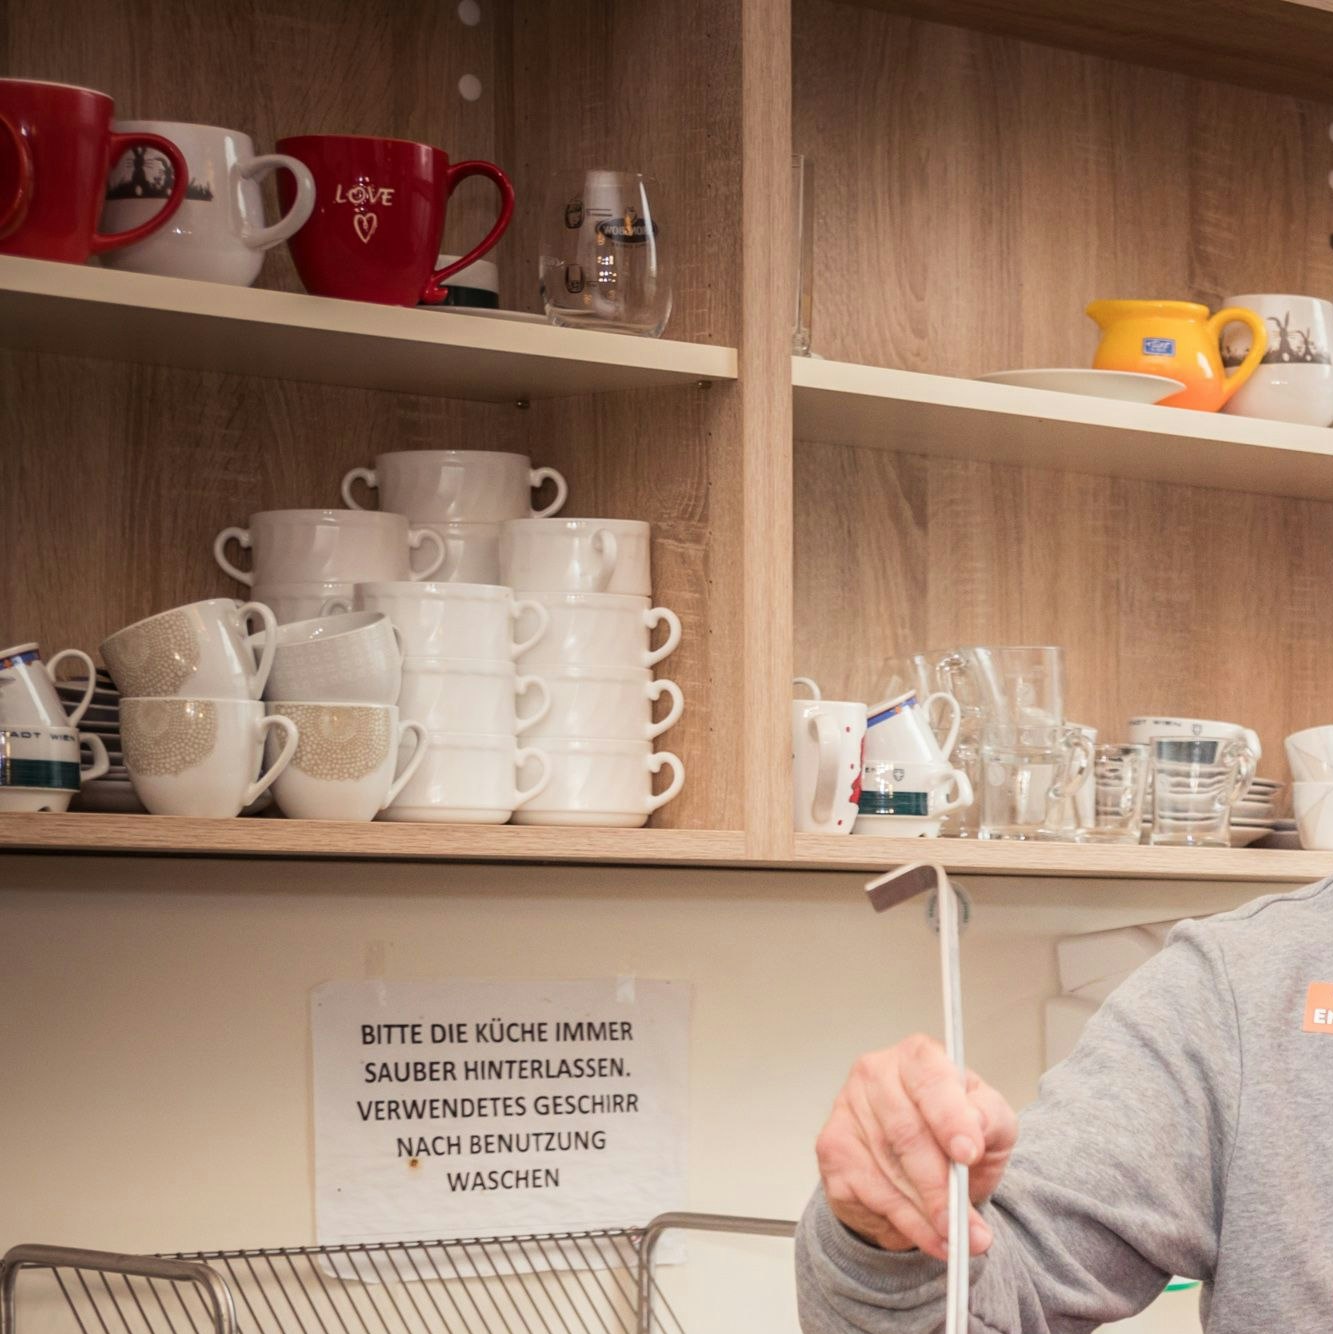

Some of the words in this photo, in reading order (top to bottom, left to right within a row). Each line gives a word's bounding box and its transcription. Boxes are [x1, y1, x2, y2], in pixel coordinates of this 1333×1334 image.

[336, 184, 395, 206] LOVE
[361, 1023, 423, 1045] BITTE
[431, 1023, 468, 1044] DIE
[476, 1017, 548, 1043] KÜCHE
[556, 1021, 633, 1042] IMMER
[364, 1061, 456, 1083] SAUBER
[465, 1058, 631, 1081] HINTERLASSEN.
[357, 1097, 526, 1121] VERWENDETES
[534, 1094, 638, 1116] GESCHIRR
[397, 1135, 461, 1157] NACH
[470, 1131, 606, 1154] BENUTZUNG
[447, 1169, 560, 1192] WASCHEN
